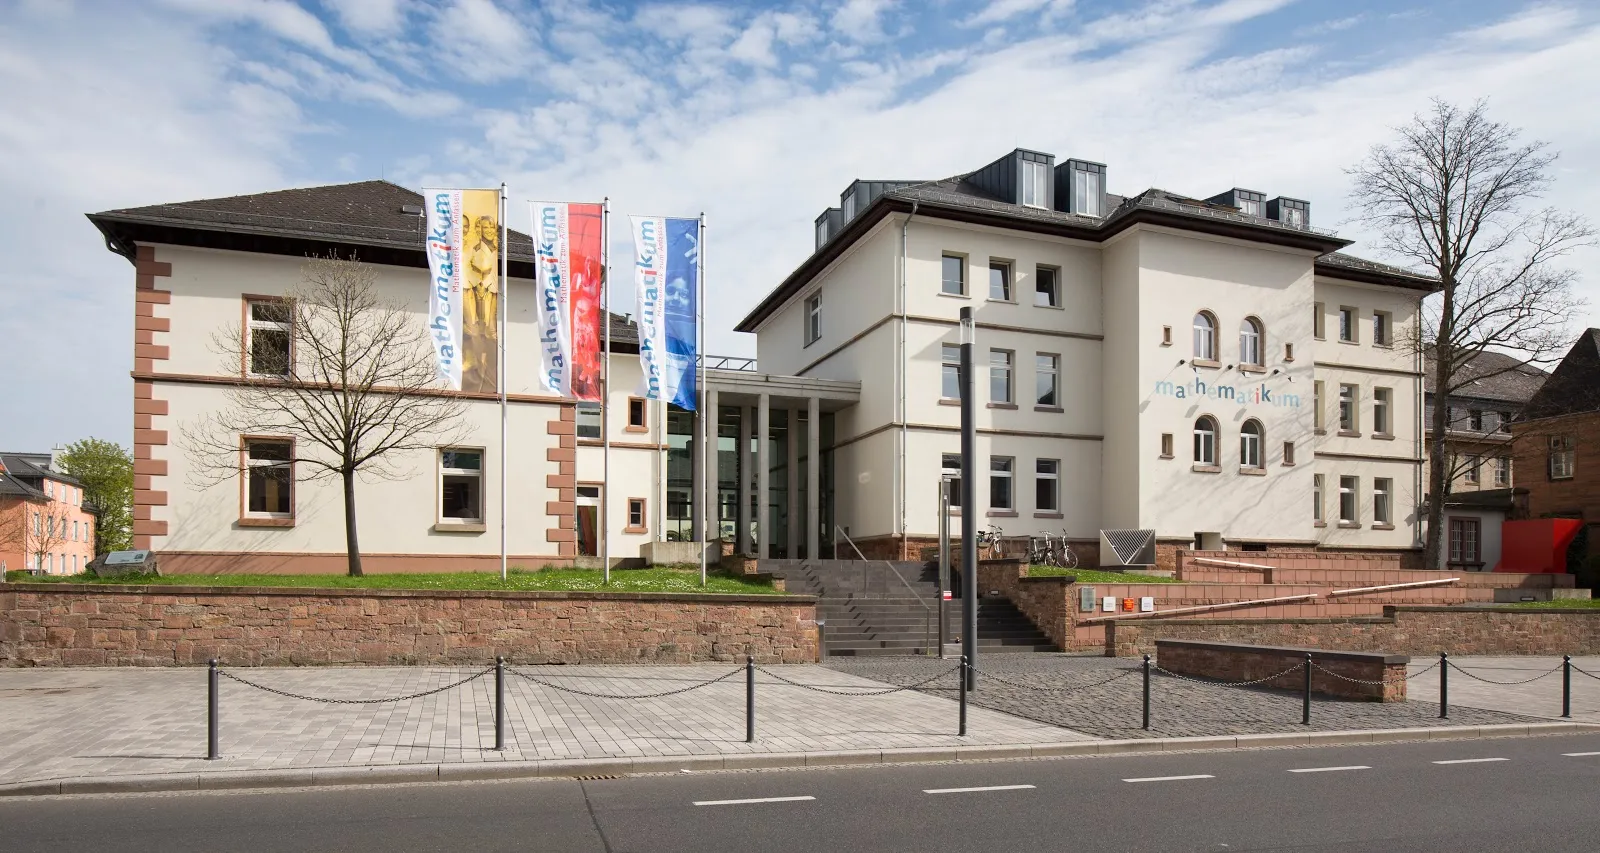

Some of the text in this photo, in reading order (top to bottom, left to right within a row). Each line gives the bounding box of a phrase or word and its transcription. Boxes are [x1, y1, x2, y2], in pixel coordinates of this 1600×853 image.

[452, 247, 460, 293] Mathematik
[537, 207, 564, 392] mathematikum
[636, 221, 660, 399] mathematikum
[1155, 376, 1300, 408] mathematikum
